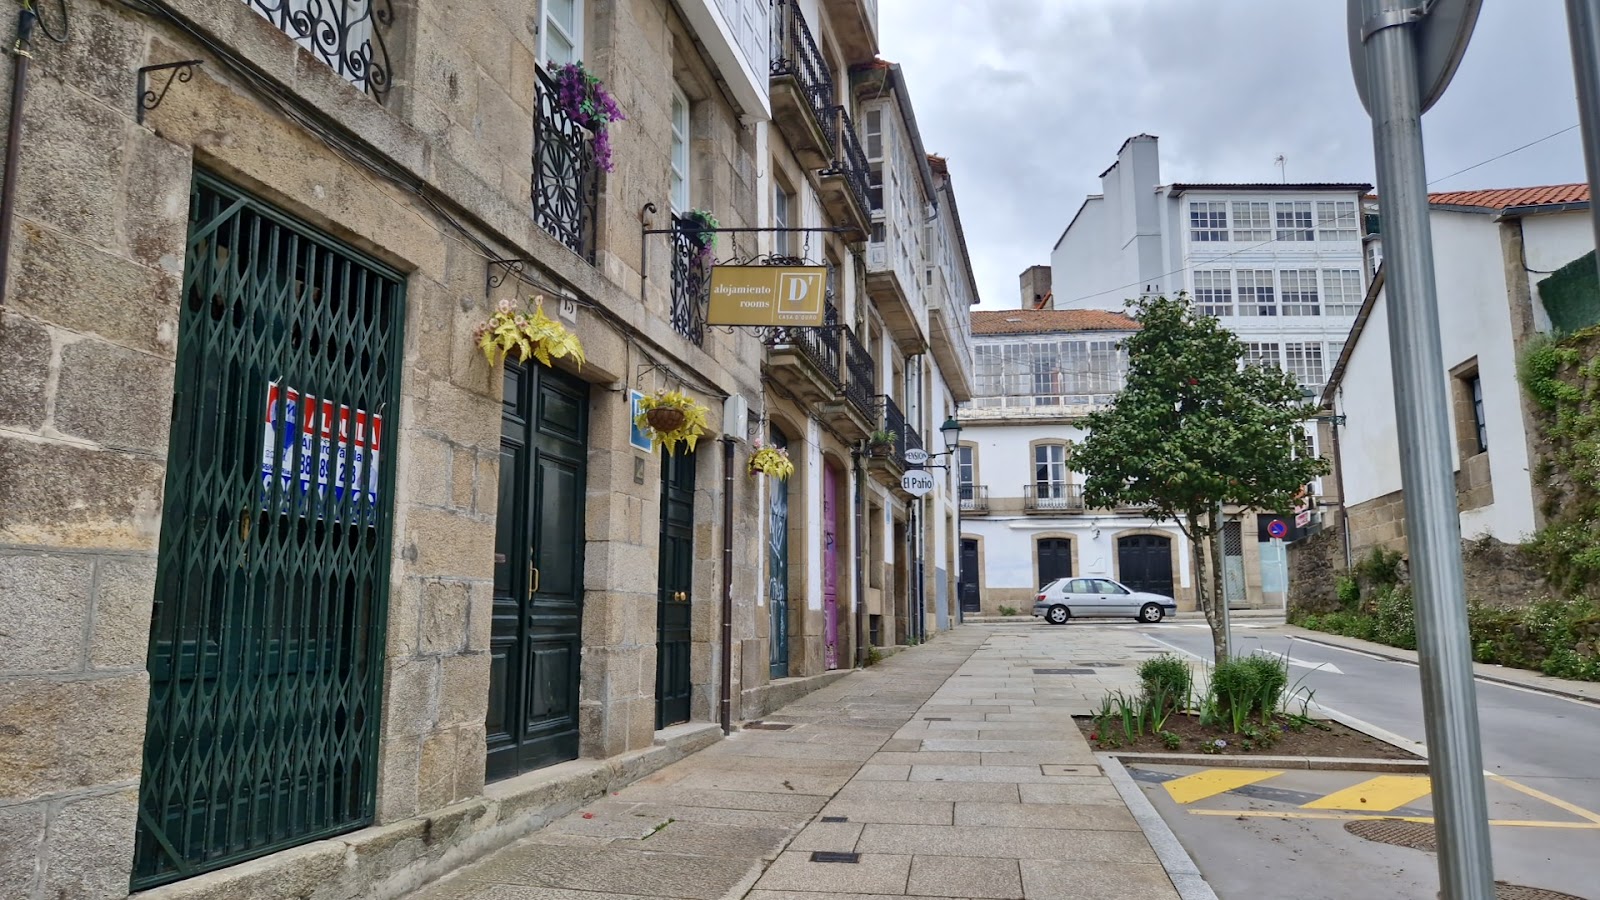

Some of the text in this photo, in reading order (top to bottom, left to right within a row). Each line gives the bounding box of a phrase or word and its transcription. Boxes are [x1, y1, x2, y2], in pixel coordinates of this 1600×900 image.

[713, 284, 771, 296] alojamiento
[788, 275, 814, 301] D'
[740, 300, 770, 308] rooms
[307, 411, 378, 445] ALULA
[903, 477, 932, 489] El Patio
